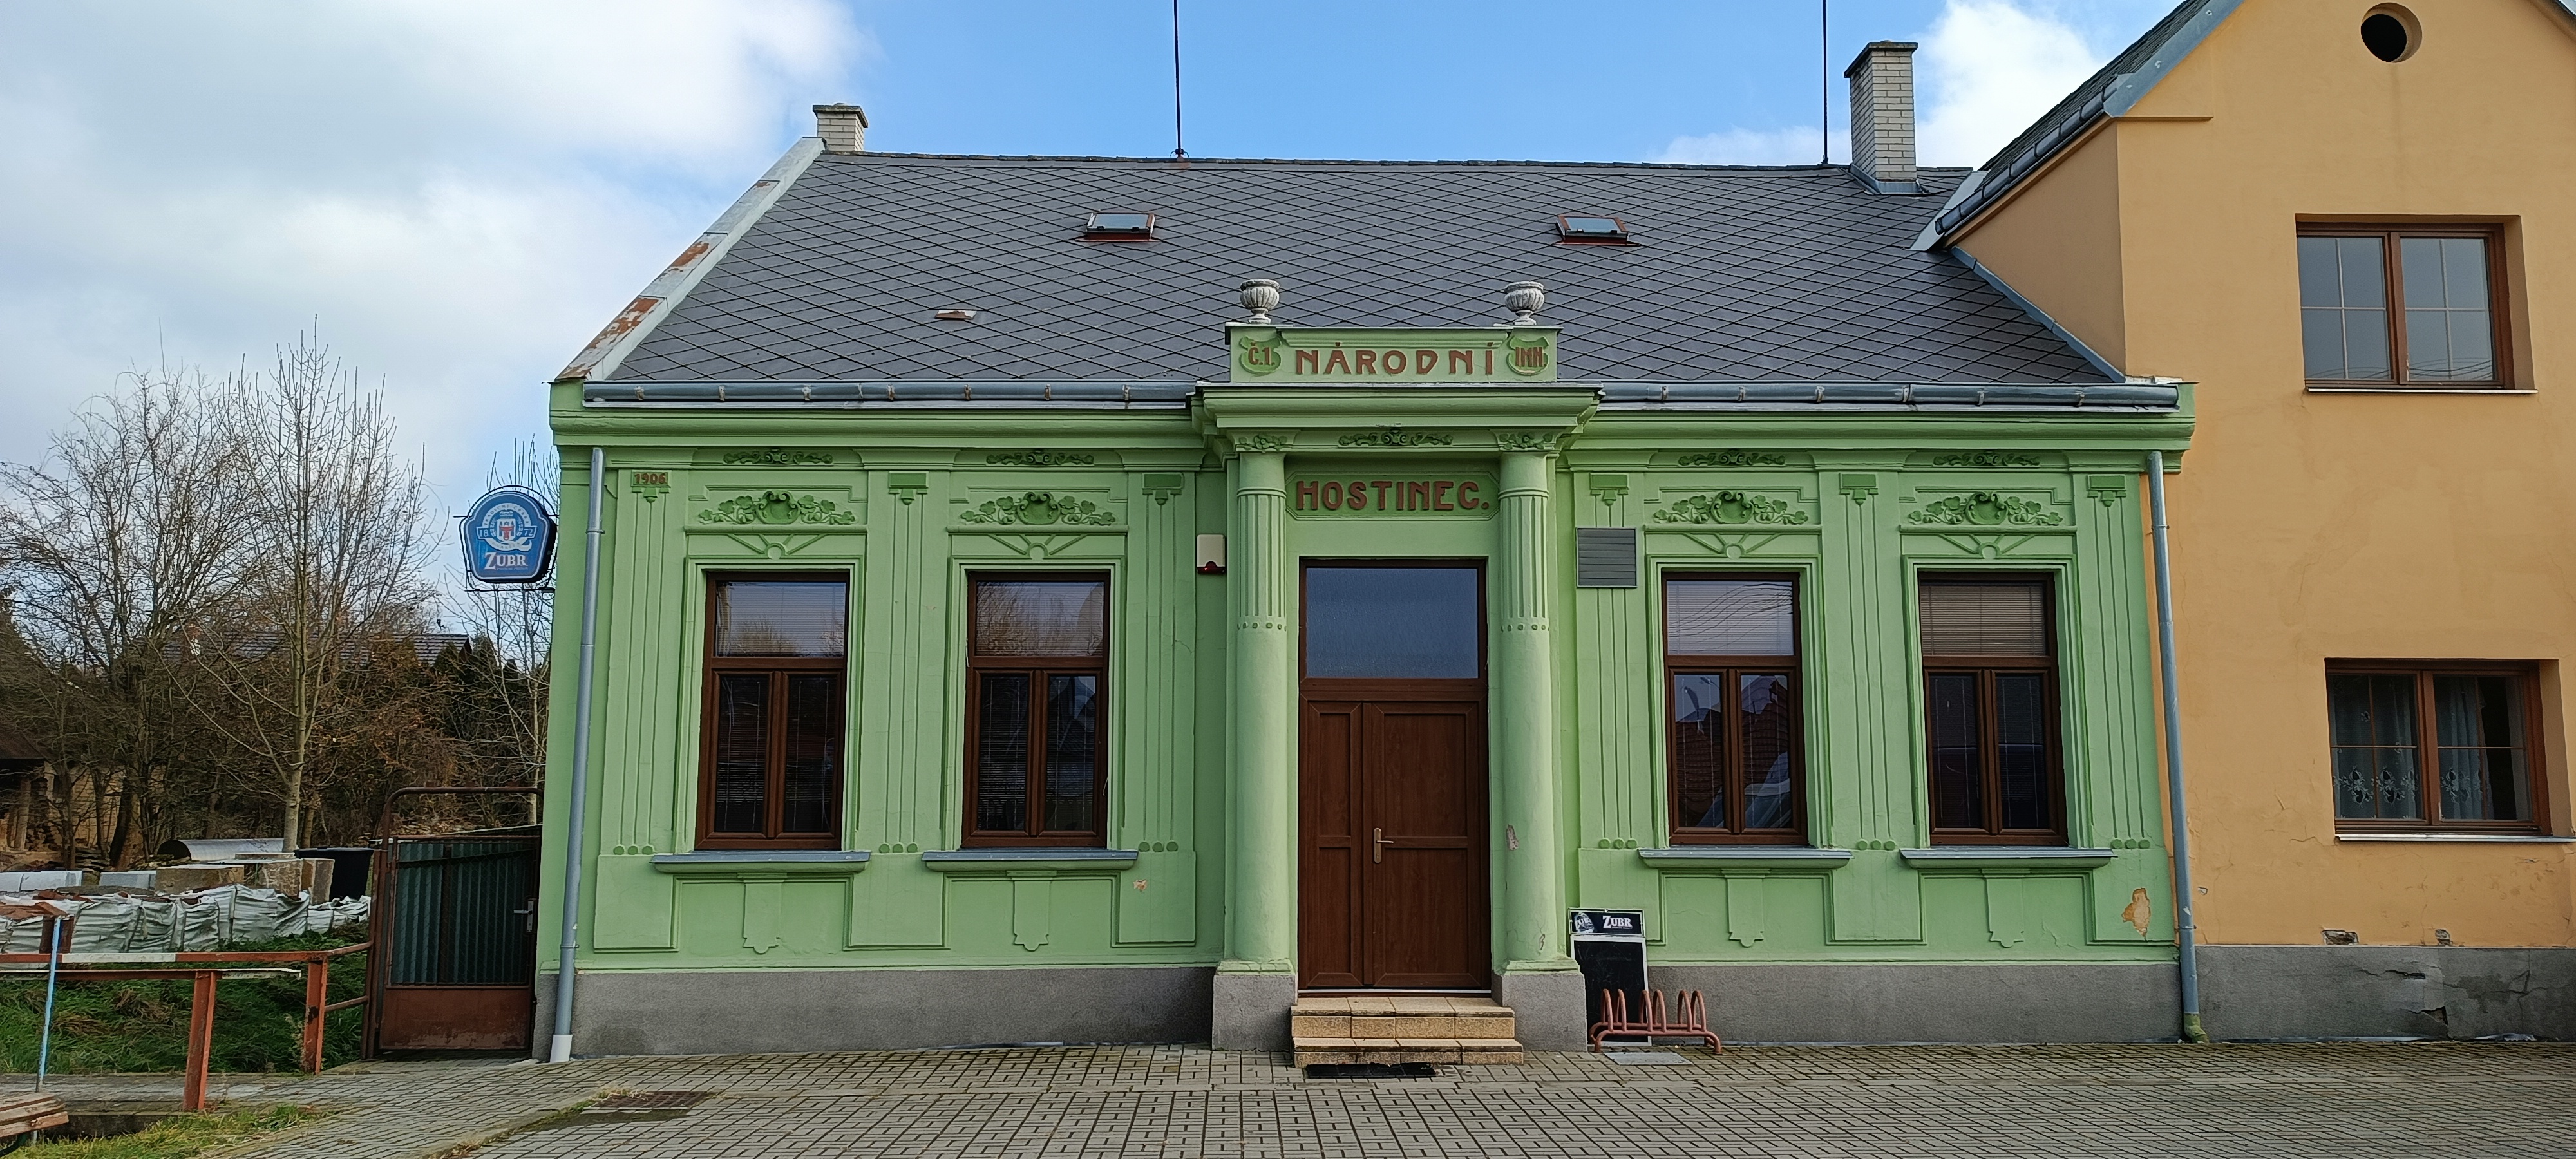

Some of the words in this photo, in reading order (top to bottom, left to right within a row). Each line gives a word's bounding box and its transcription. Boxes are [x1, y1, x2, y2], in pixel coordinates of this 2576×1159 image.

[1296, 341, 1493, 375] NÁRODNÍ
[634, 473, 666, 485] 1906
[1296, 480, 1490, 511] HOSTINEC.
[524, 528, 533, 536] 72
[484, 552, 528, 570] ZUBR
[1602, 915, 1633, 928] ZUBR
